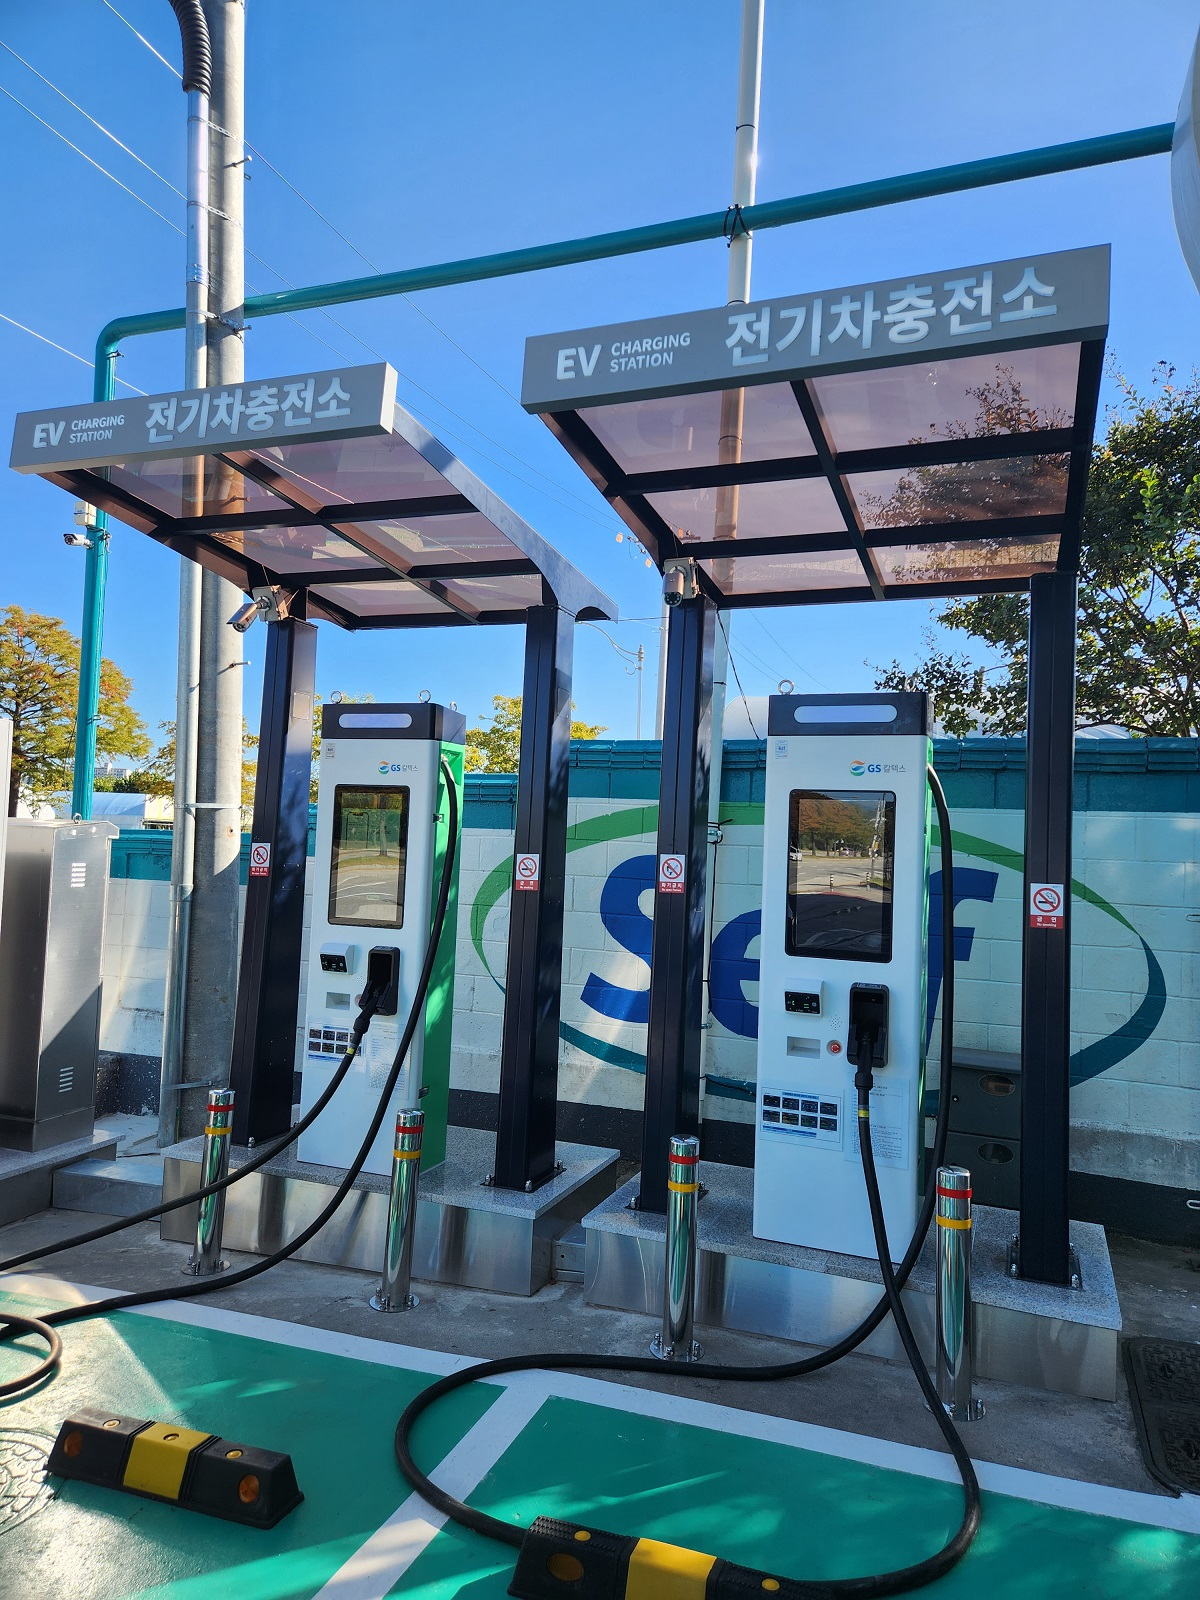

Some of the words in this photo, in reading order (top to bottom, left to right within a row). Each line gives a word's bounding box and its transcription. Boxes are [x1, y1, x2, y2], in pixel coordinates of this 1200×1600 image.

[725, 266, 1058, 368] 전기차충전소
[611, 332, 691, 356] CHARGING
[556, 344, 602, 381] EV
[610, 351, 673, 373] STATION
[144, 376, 352, 444] 전기차충전소
[71, 414, 125, 431] CHARGING
[33, 421, 66, 449] EV
[69, 429, 113, 444] STATION
[390, 764, 401, 772] GS
[867, 764, 882, 773] GS
